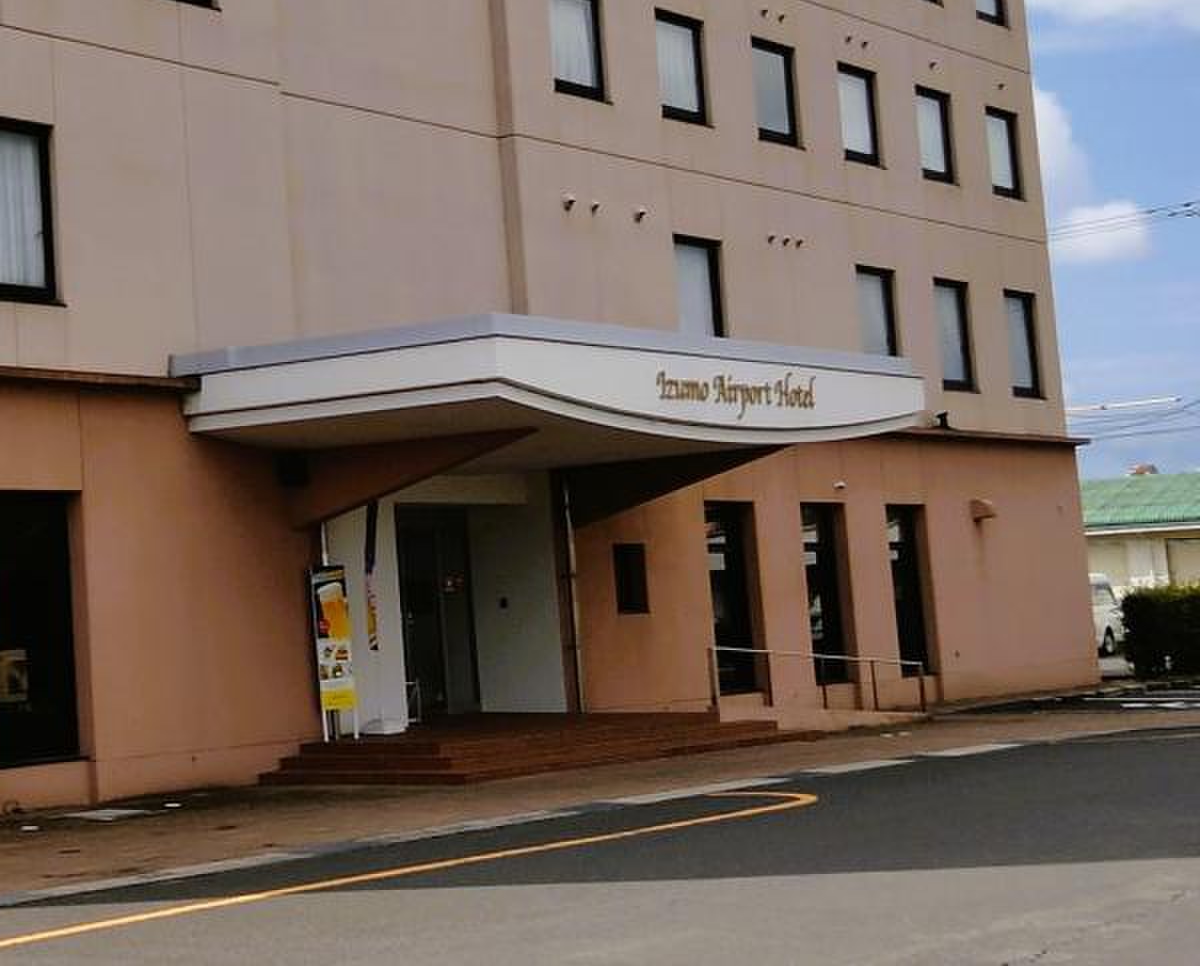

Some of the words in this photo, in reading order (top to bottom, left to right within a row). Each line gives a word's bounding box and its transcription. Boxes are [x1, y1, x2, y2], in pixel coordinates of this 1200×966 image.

[656, 370, 708, 401] Izumo
[713, 374, 772, 420] Airport
[773, 371, 816, 409] Hotel
